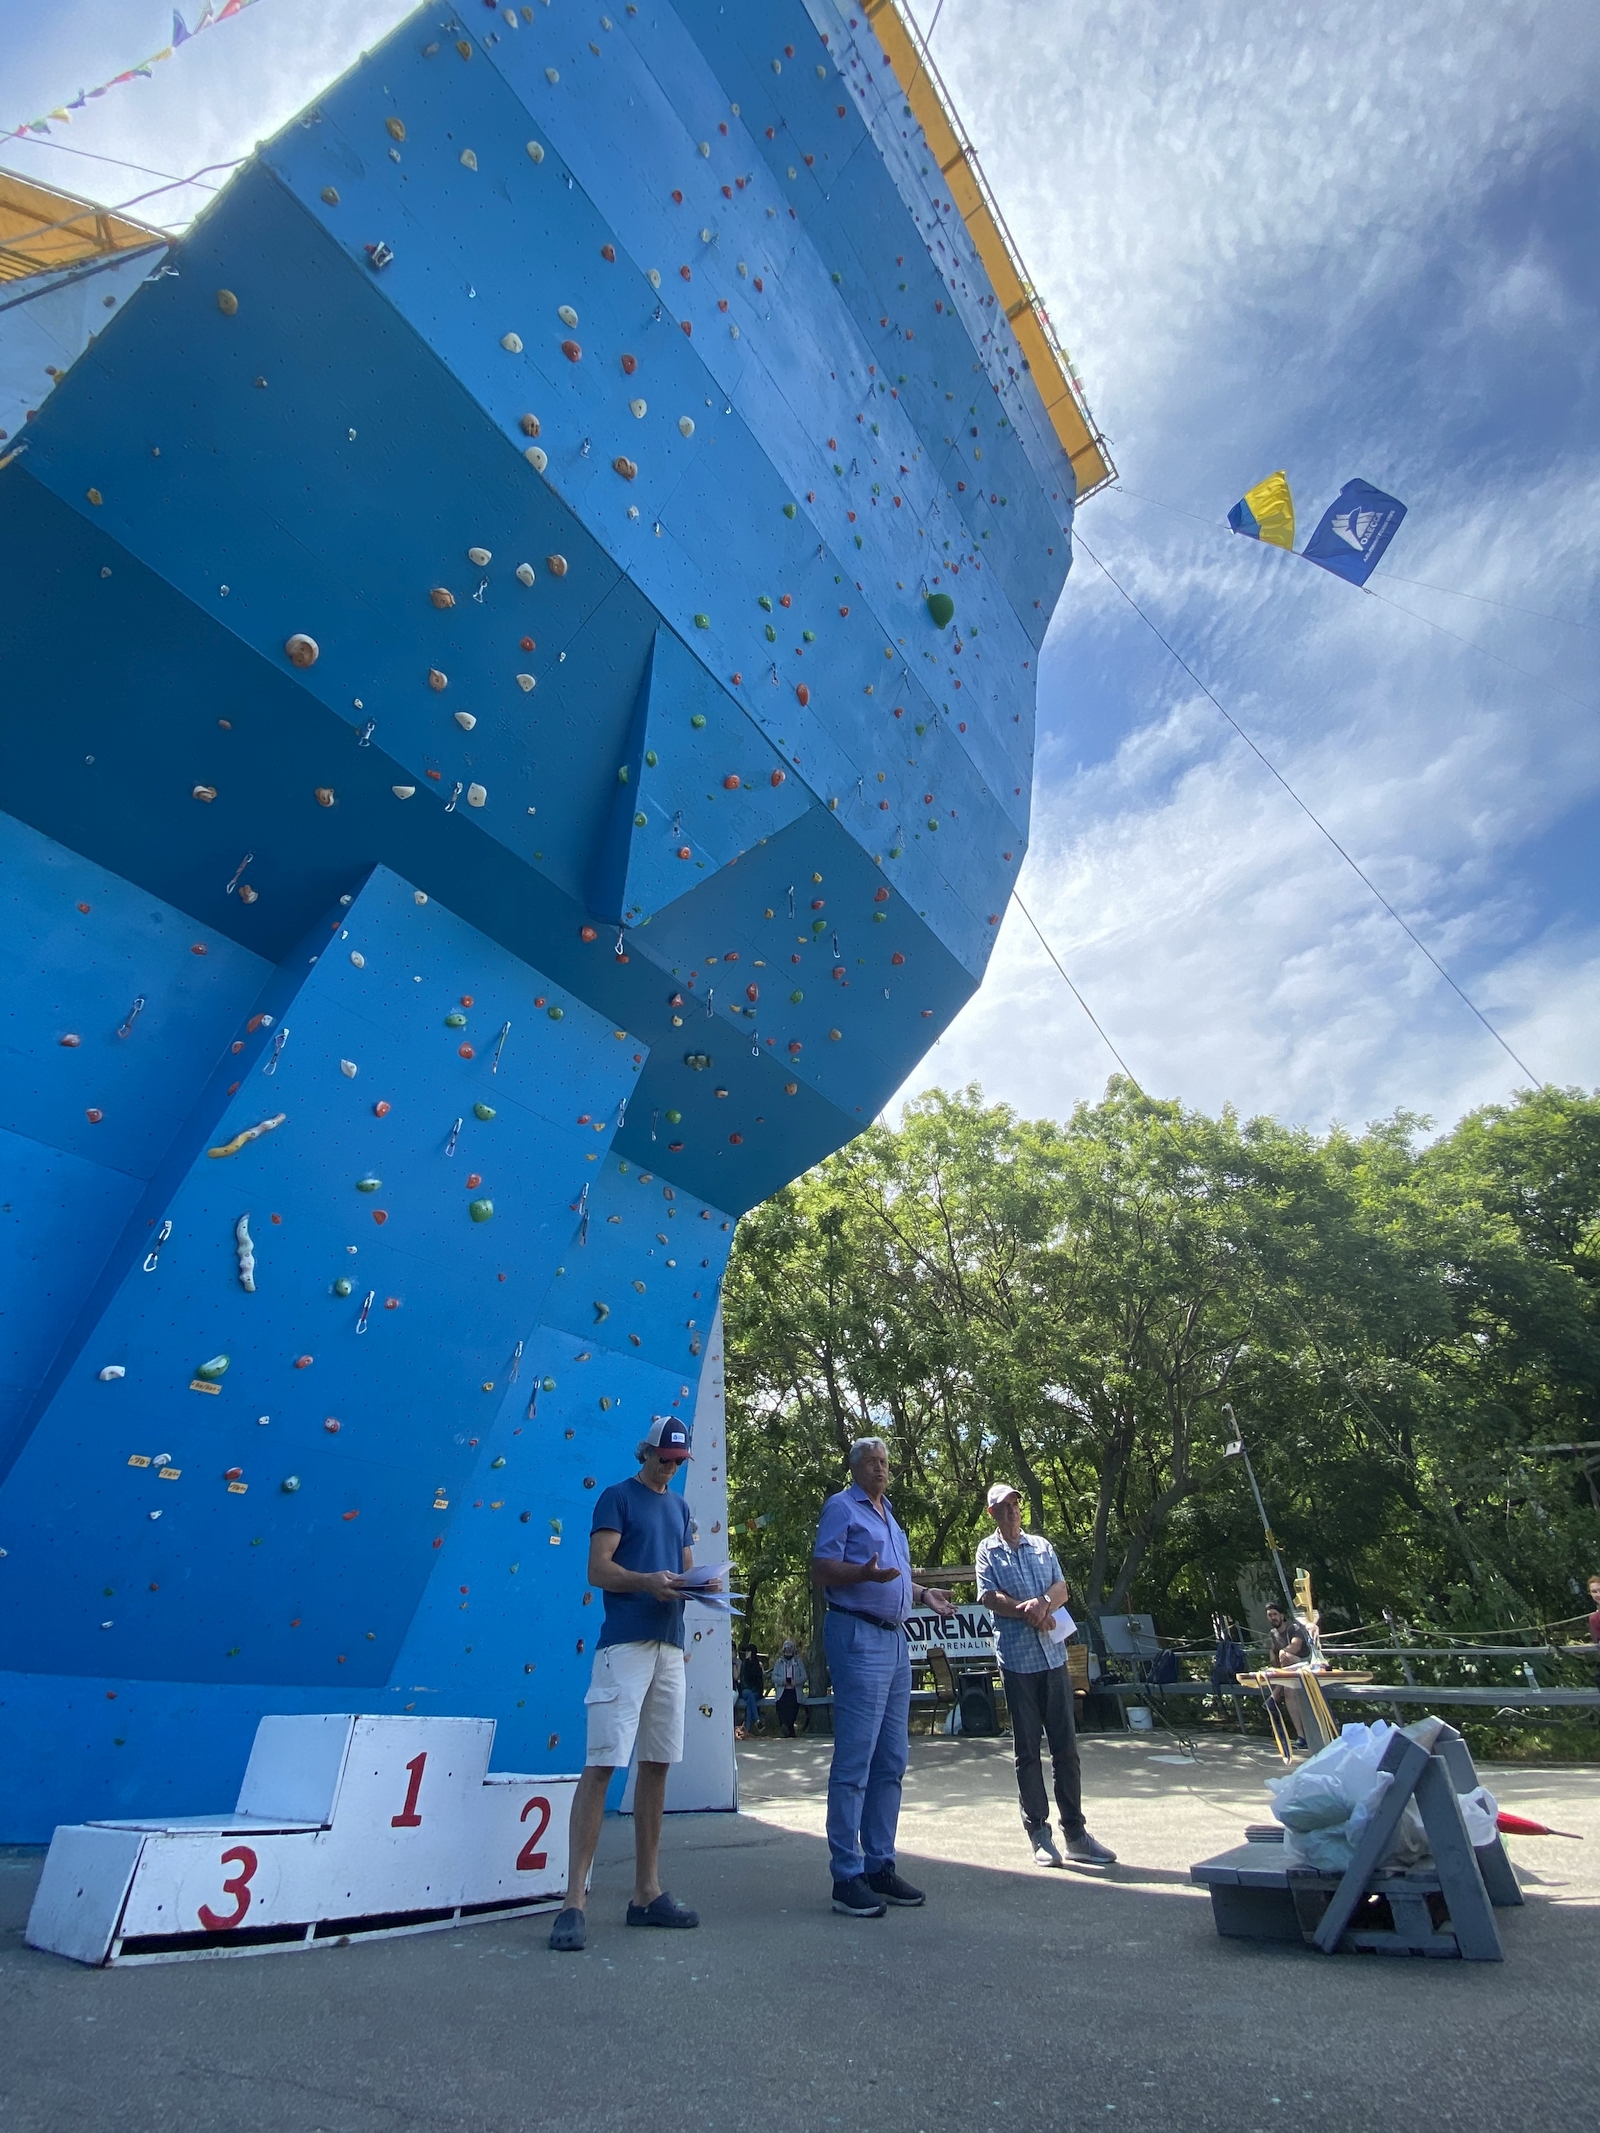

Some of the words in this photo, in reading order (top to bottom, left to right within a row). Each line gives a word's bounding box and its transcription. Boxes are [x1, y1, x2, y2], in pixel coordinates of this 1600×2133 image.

[901, 1612, 994, 1642] DRENA
[391, 1751, 427, 1828] 1
[516, 1796, 552, 1871] 2
[197, 1845, 259, 1931] 3
